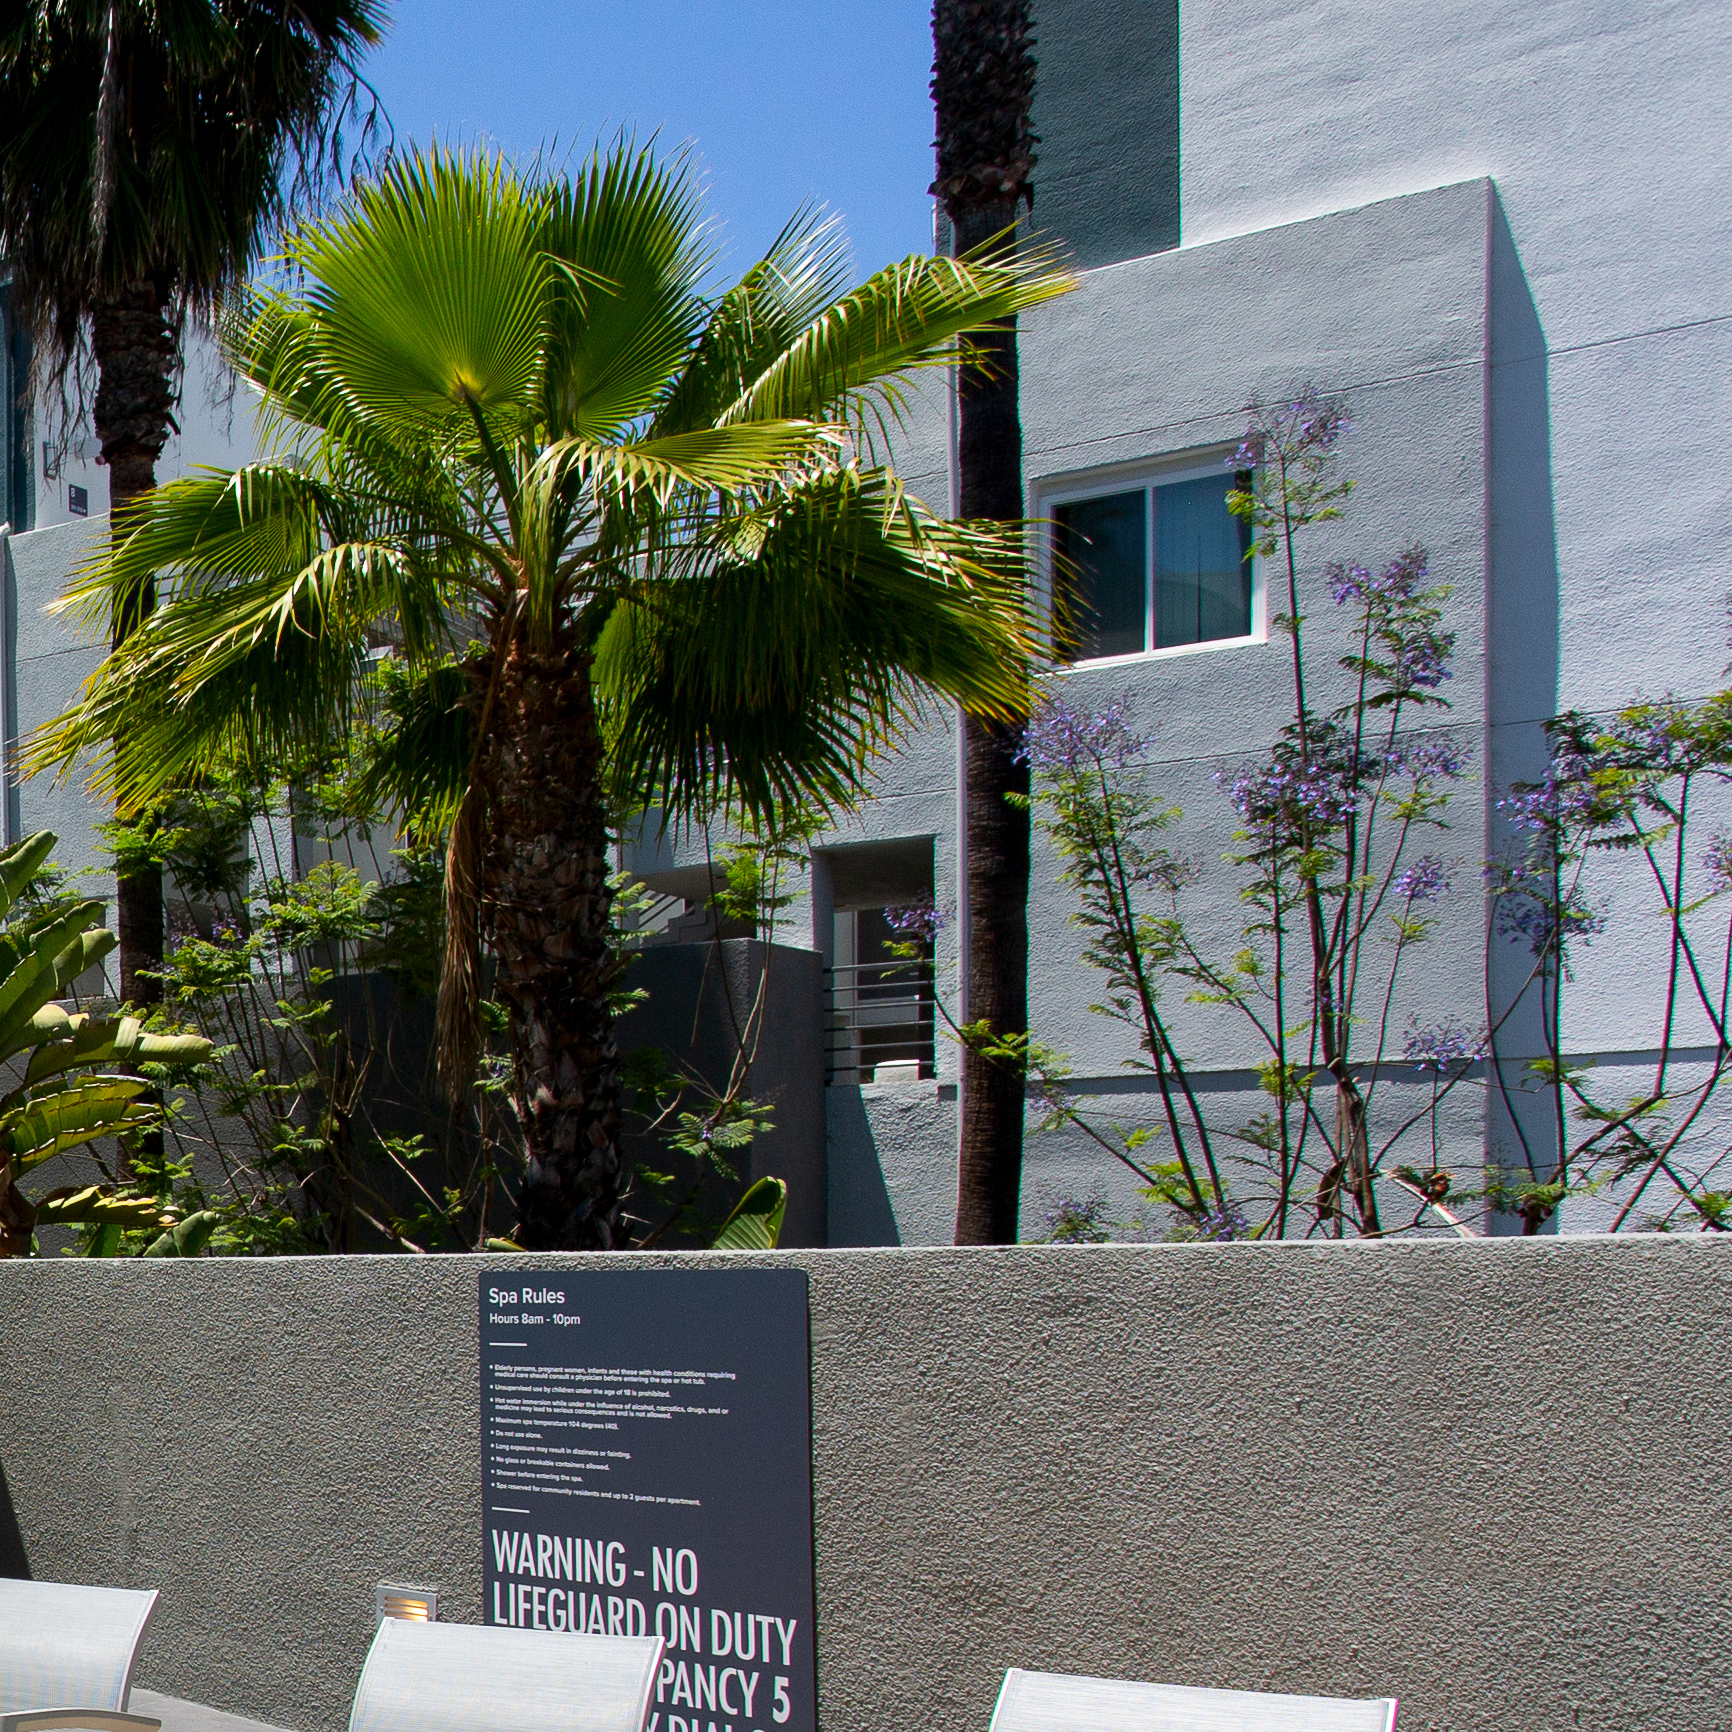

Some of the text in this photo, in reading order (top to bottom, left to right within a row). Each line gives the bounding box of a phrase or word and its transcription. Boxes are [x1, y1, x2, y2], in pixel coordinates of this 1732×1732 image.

[488, 1287, 566, 1307] Spa Rules
[489, 1313, 519, 1324] Hours
[521, 1313, 544, 1324] 8am
[552, 1313, 581, 1327] 10pm
[492, 1529, 626, 1587] WARNING
[652, 1546, 699, 1596] NO
[493, 1581, 797, 1666] LIFEGUARD ON DUTY
[772, 1675, 791, 1724] 5
